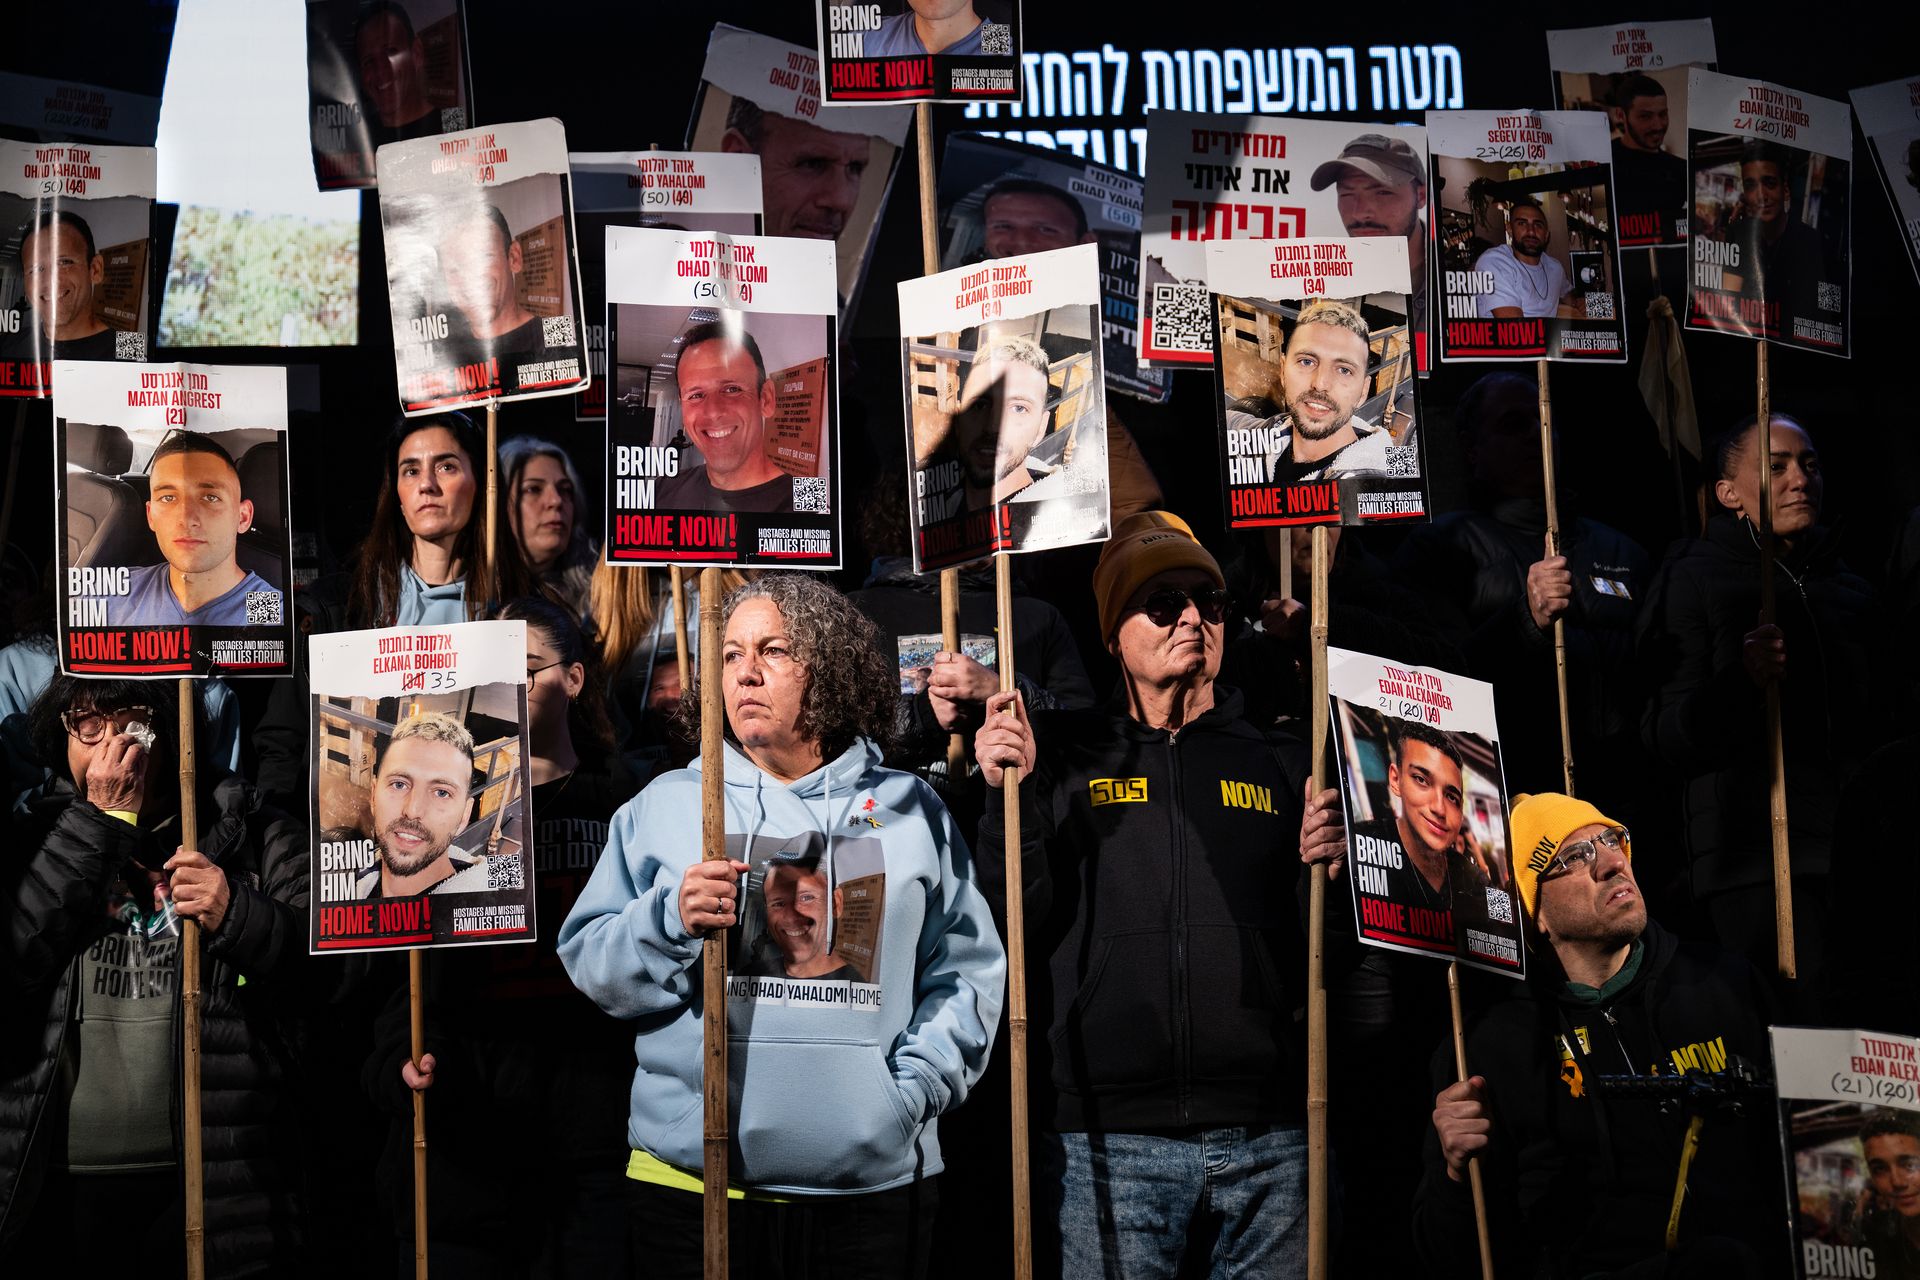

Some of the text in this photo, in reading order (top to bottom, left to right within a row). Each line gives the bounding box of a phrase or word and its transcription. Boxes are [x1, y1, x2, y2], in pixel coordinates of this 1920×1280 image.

[829, 4, 882, 31] BRING
[831, 33, 864, 58] HIM
[1612, 41, 1653, 56] ITAY CHEN
[769, 67, 799, 91] OHAD
[832, 56, 934, 88] HOME NOW!
[952, 69, 1013, 78] HOSTAGES AND MISSING
[952, 77, 1013, 90] FAMILIES FORUM
[1142, 45, 1464, 114] מטה המשפחות
[317, 104, 361, 126] BRING
[795, 95, 818, 119] (49)
[1739, 100, 1810, 129] EDAN ALEXANDER
[1497, 116, 1542, 130] שגב כלפון
[440, 138, 470, 155] יהלומי
[1192, 129, 1287, 158] מחזירים
[1488, 130, 1553, 145] SEGEV KALFON
[67, 149, 91, 163] אוהד
[638, 158, 694, 173] אוהד יהלומי
[24, 164, 101, 180] OHAD YAHALOMI
[628, 175, 705, 188] OHAD YAHALOMI
[1185, 164, 1290, 194] את איתי
[640, 191, 670, 206] (50)
[1071, 180, 1105, 199] OHAD
[1171, 199, 1306, 241] הביתה
[1275, 244, 1346, 261] אלקנה בוחבוט
[1695, 235, 1740, 268] BRING
[677, 260, 709, 277] OHAD
[961, 265, 1027, 291] אלקנה בוחבוט
[1271, 262, 1353, 279] ELKANA BOHBOT
[1695, 262, 1723, 290] HIM
[1304, 278, 1325, 295] (34)
[1445, 270, 1494, 294] BRING
[956, 280, 1033, 310] ELKANA BOHBOT
[1447, 295, 1478, 318] HIM
[1695, 289, 1735, 319] HOME
[981, 300, 1002, 319] (34)
[1449, 319, 1545, 345] HOME NOW!
[1560, 330, 1618, 339] HOSTAGES MISSING
[1561, 338, 1619, 351] FAMILIES FORUM
[517, 363, 543, 373] HOSTAGES
[544, 361, 555, 370] AND
[556, 358, 578, 368] MISSING
[518, 366, 580, 386] FAMILIES FORUM
[142, 372, 208, 390] מתן אנגרסט
[128, 390, 222, 409] MATAN ANGREST
[166, 408, 187, 425] (21)
[1227, 428, 1282, 456] BRING
[616, 446, 678, 477] BRING
[1229, 457, 1264, 485] HIM
[916, 460, 960, 498] BRING
[616, 479, 655, 510] HIM
[1231, 480, 1340, 516] HOME NOW!
[1357, 492, 1421, 502] HOSTAGES AND MISSING
[918, 494, 948, 527] HIM
[1358, 500, 1423, 514] FAMILIES FORUM
[616, 513, 738, 548] HOME NOW!
[758, 528, 831, 540] HOSTAGES AND MISSING
[758, 539, 831, 554] FAMILIES FORUM
[68, 567, 130, 597] BRING
[69, 598, 108, 627] HIM
[70, 627, 192, 660] HOME NOW!
[212, 641, 284, 650] HOSTAGES AND MISSING
[379, 634, 452, 654] אלקנה בוחבוט
[212, 651, 284, 664] FAMILIES FORUM
[373, 652, 459, 674] ELKANA BOHBOT
[402, 672, 425, 691] (34)
[431, 671, 456, 689] 35
[1383, 665, 1442, 692] עידן אלכסנדר
[1378, 679, 1453, 711] EDAN ALEXANDER
[1379, 696, 1392, 710] 21
[1093, 779, 1144, 803] SOS
[1220, 779, 1279, 815] NOW.
[320, 839, 375, 871] BRING
[1355, 833, 1402, 870] BRING
[320, 872, 357, 902] HIM
[1357, 864, 1389, 897] HIM
[320, 897, 432, 936] HOME NOW!
[453, 904, 525, 918] HOSTAGES AND MISSING
[1361, 897, 1454, 941] HOME NOW!
[454, 915, 526, 932] FAMILIES FORUM
[750, 982, 881, 1006] OHAD YAHALOMI HOME
[1860, 1038, 1916, 1063] אלכסנדר
[1851, 1056, 1885, 1076] EDAN
[1803, 1240, 1876, 1279] BRING
